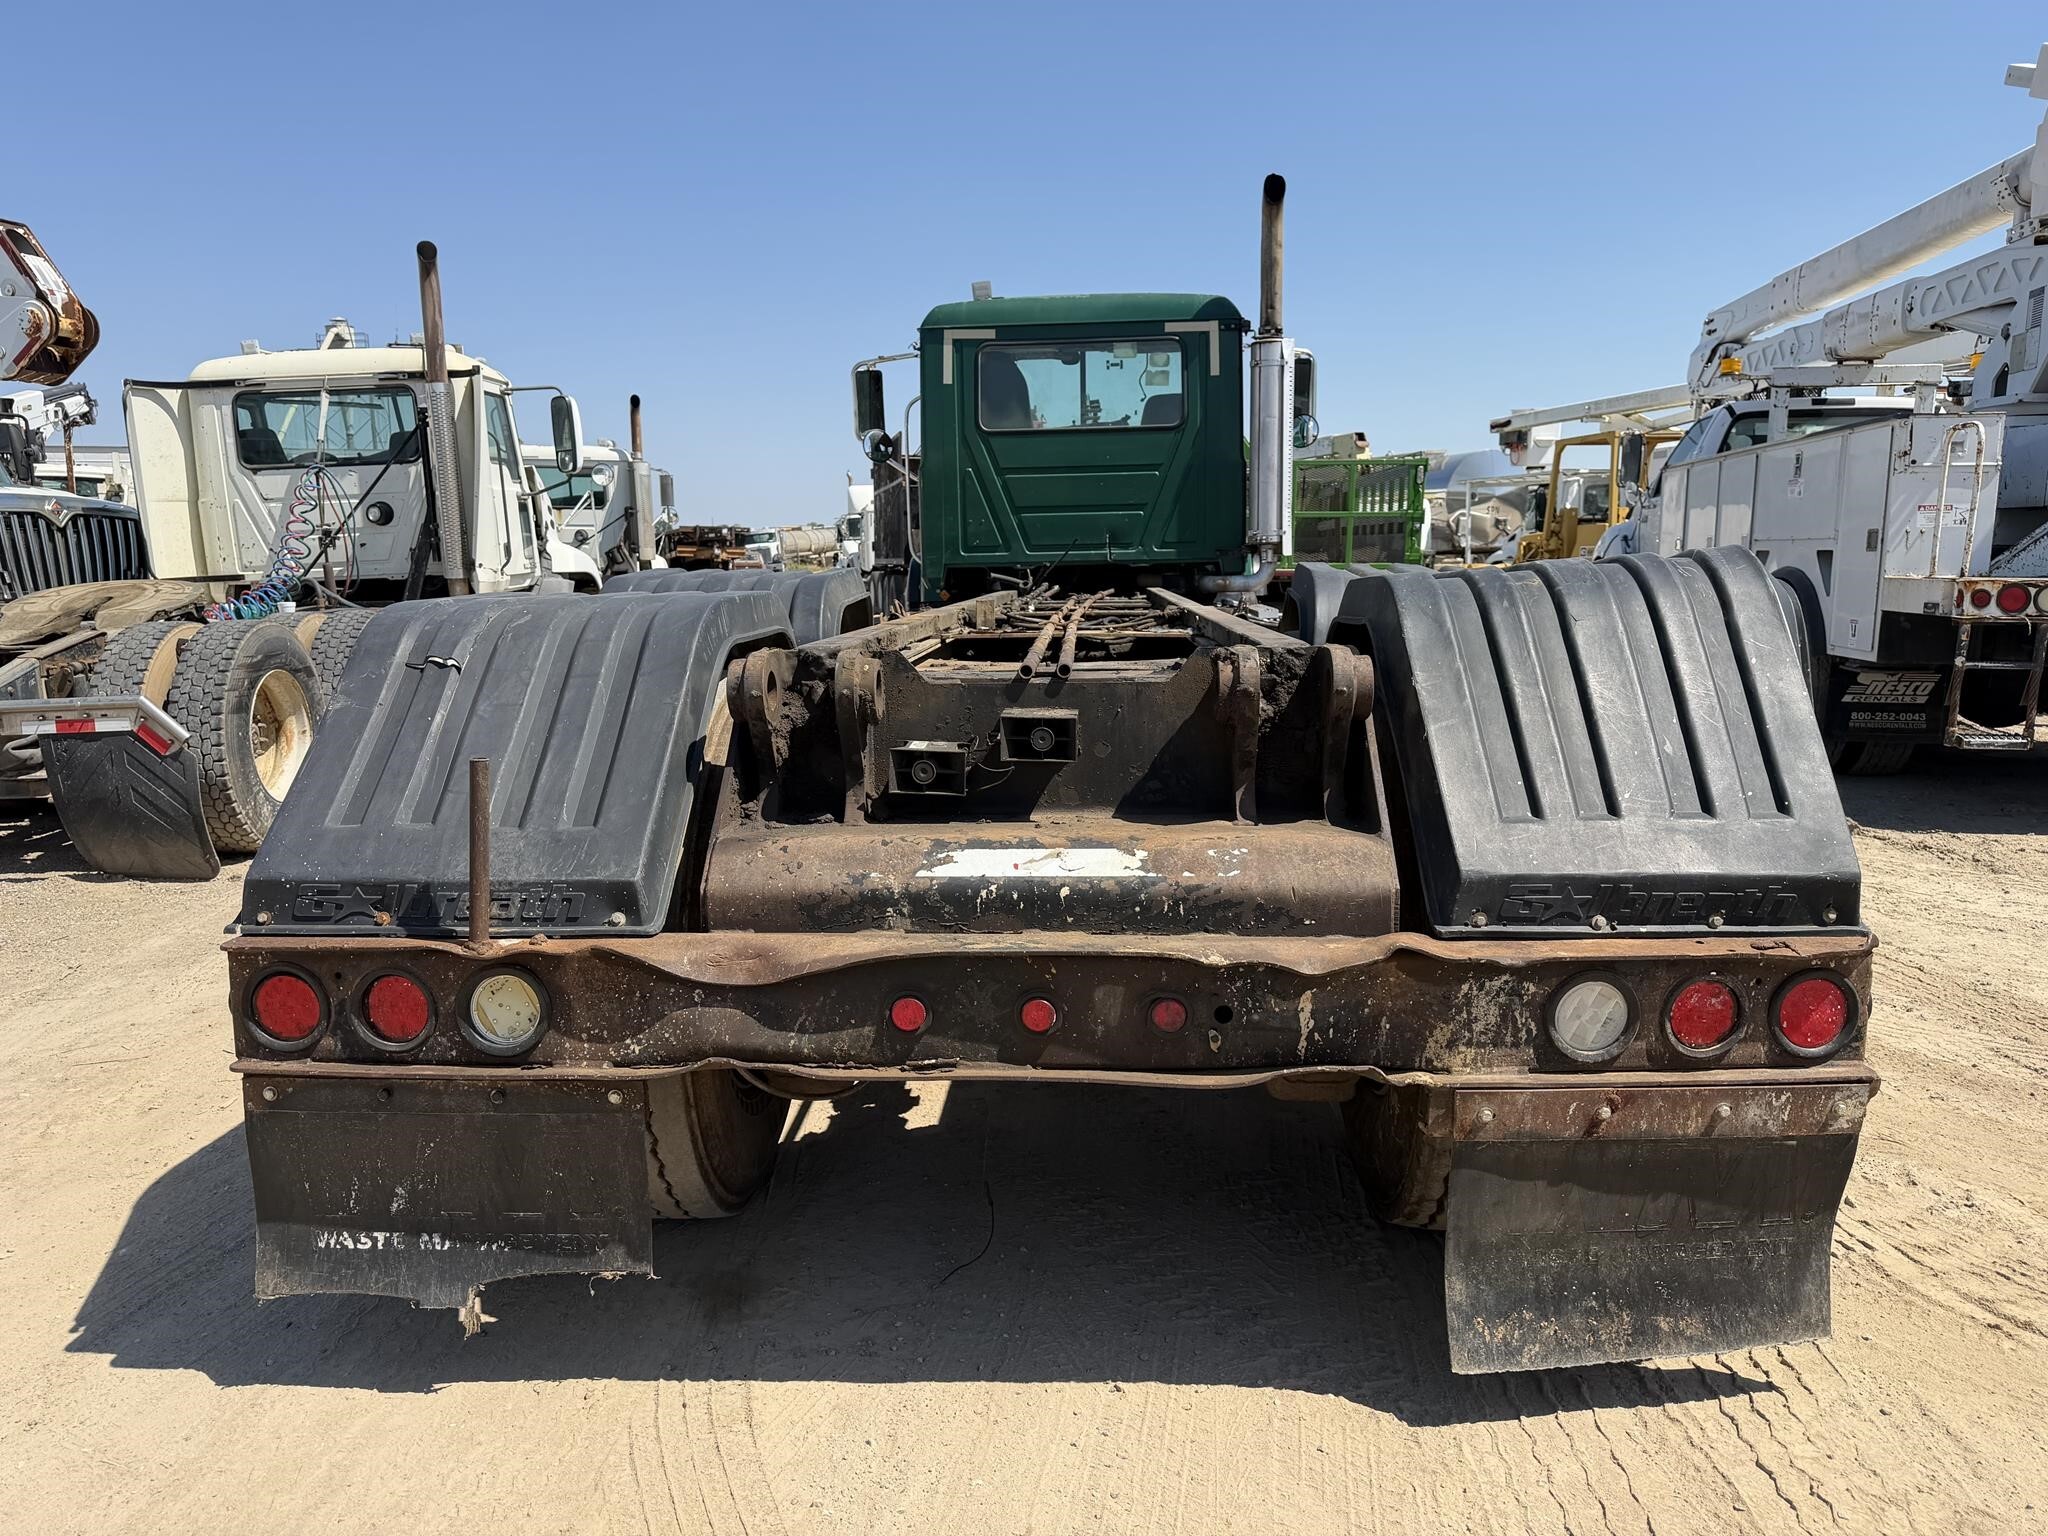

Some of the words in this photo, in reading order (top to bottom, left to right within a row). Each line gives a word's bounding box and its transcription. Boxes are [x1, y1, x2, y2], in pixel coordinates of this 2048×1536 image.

[1865, 681, 1936, 695] NESCO
[1850, 695, 1920, 703] RENTALS
[1850, 711, 1927, 721] 800-252-0043
[314, 1231, 406, 1250] WASTE
